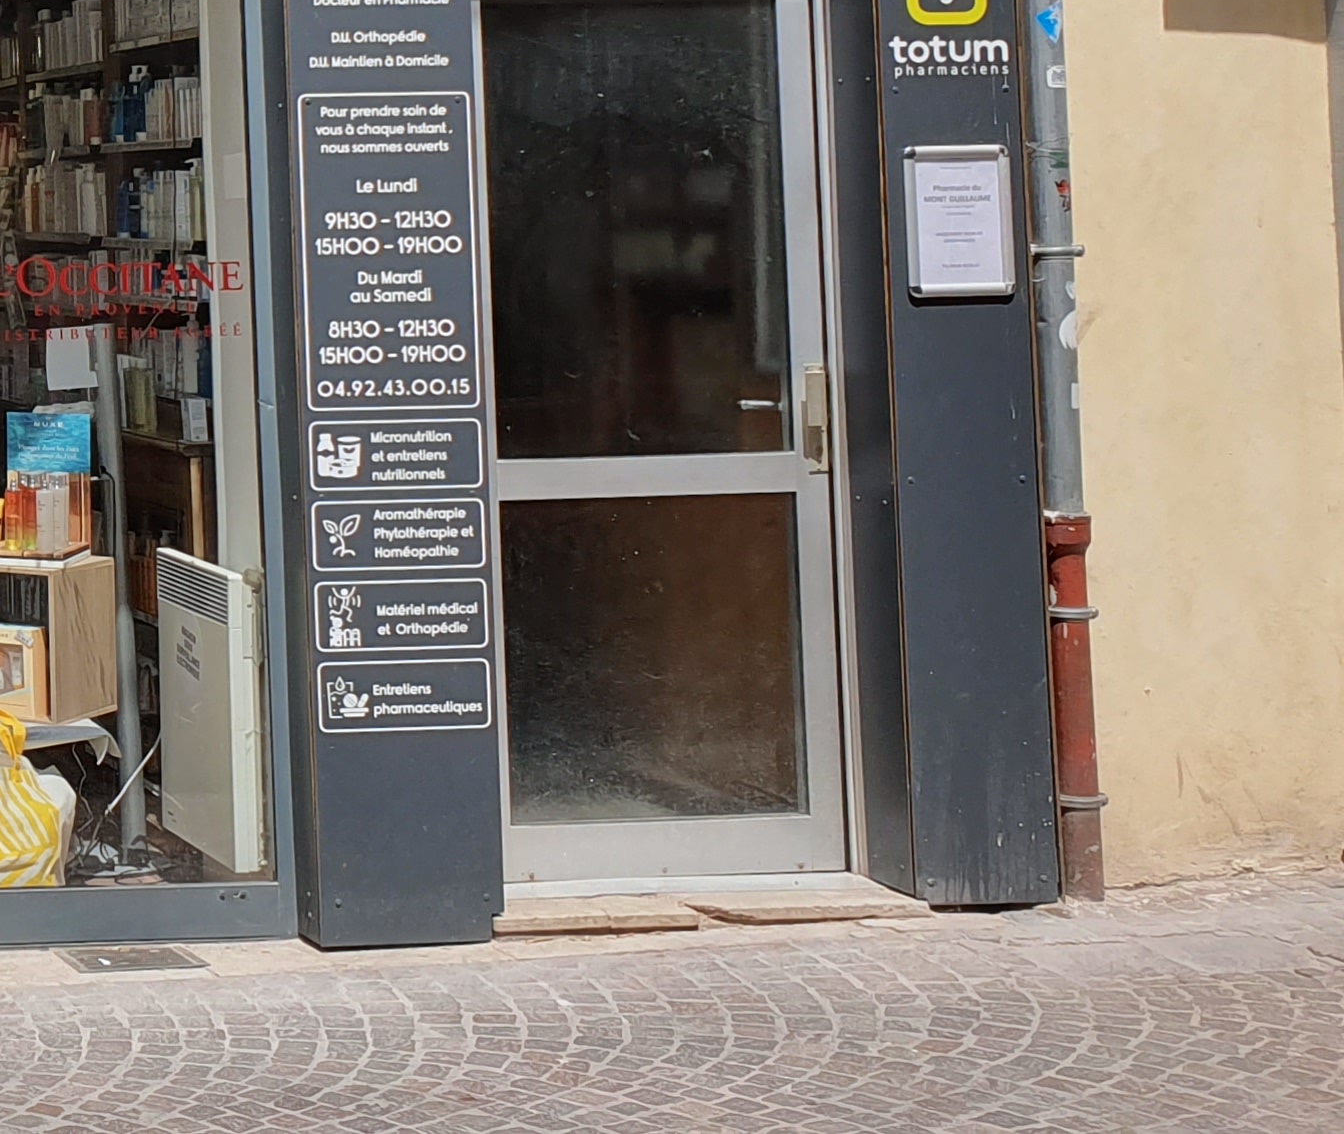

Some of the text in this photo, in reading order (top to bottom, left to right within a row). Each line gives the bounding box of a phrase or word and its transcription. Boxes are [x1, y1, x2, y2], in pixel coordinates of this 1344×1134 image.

[353, 29, 426, 46] Orthopédie
[888, 35, 1009, 64] totum
[331, 54, 383, 68] Maintien
[385, 54, 394, 67] à
[396, 54, 449, 67] Domicile
[894, 62, 1009, 79] pharmaciens
[320, 103, 447, 121] Pour prendre soin de
[315, 125, 343, 136] vous
[345, 123, 354, 136] à
[356, 123, 405, 138] chaque
[320, 140, 449, 154] nous sommes ouverts
[356, 177, 418, 194] Le Lundi
[324, 209, 452, 230] 9H30 12H30
[314, 234, 463, 256] 15H00 19H00
[357, 269, 423, 285] Du Mardi
[349, 286, 432, 303] au Samedi
[34, 304, 60, 317] EN
[328, 318, 455, 339] 8H30 12H30
[318, 343, 467, 365] 15H00 19H00
[316, 377, 471, 398] 04.92.43.00.15
[370, 430, 452, 444] Micronutrition
[371, 449, 448, 462] et entretiens
[371, 467, 446, 482] nutritionnels
[373, 507, 467, 522] Aromathérapie
[373, 525, 474, 541] Phytothérapie et
[374, 545, 460, 560] Homéopathie
[376, 601, 478, 617] Matériel médical
[377, 621, 469, 637] et Orthopédie
[372, 683, 432, 696] Entretiens
[373, 700, 483, 718] pharmaceutiques
